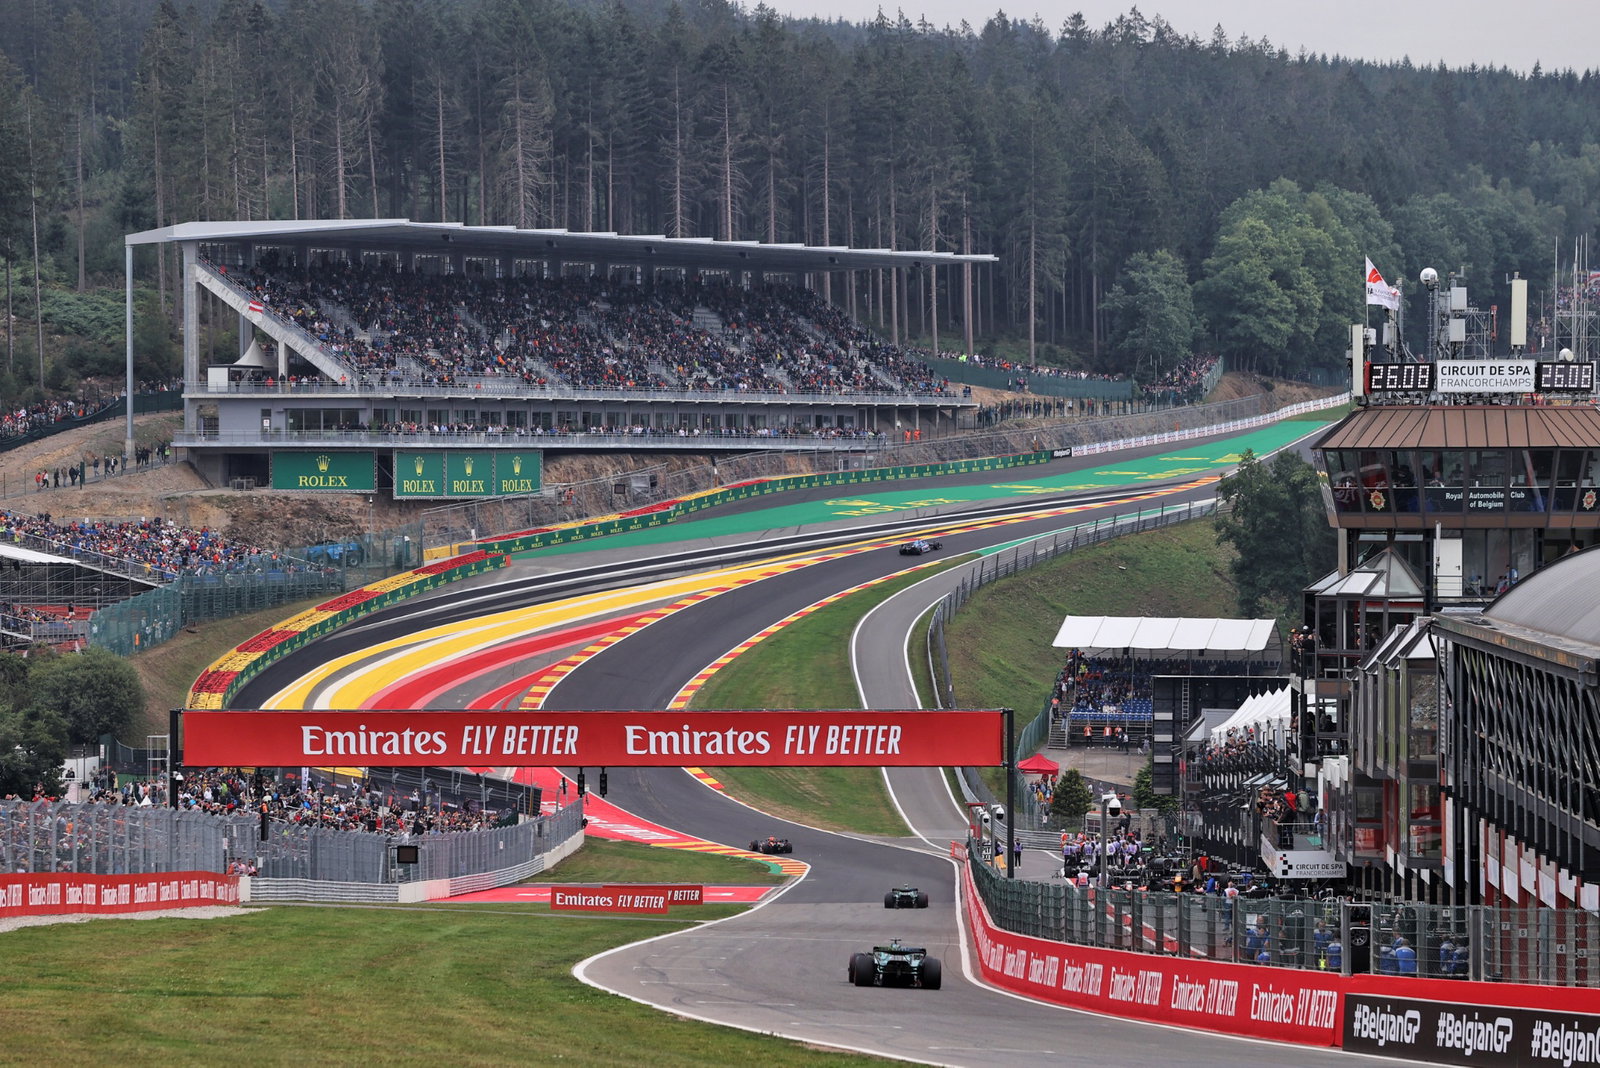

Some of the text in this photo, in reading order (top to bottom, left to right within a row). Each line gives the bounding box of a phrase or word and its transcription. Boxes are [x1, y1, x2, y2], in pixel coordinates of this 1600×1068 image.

[1371, 365, 1430, 389] 26.08
[1440, 365, 1531, 376] CIRCUIT DE SPA
[1541, 364, 1592, 388] 26.08
[1440, 378, 1532, 388] FRANCORCHAMPS
[298, 475, 348, 487] ROLEX
[403, 480, 435, 493] ROLEX
[453, 480, 485, 493] ROLEX
[502, 479, 532, 492] ROLEX
[1446, 491, 1525, 501] Royal Automobile Club
[1470, 500, 1504, 510] of Belgium
[300, 724, 902, 756] Emirates FLY BETTER Emirates FLY BETTER
[556, 892, 613, 907] Emirates
[618, 894, 632, 908] FLY
[634, 896, 664, 909] BETTER
[673, 890, 700, 901] BETTER
[1108, 966, 1163, 1006] Emirates FLY BETTER
[1171, 974, 1239, 1017] Emirates FLY BETTER
[1250, 984, 1338, 1029] Emirates FLY BETTER
[1353, 1003, 1421, 1047] #BelgianGP
[1436, 1011, 1514, 1056] #BelgianGP
